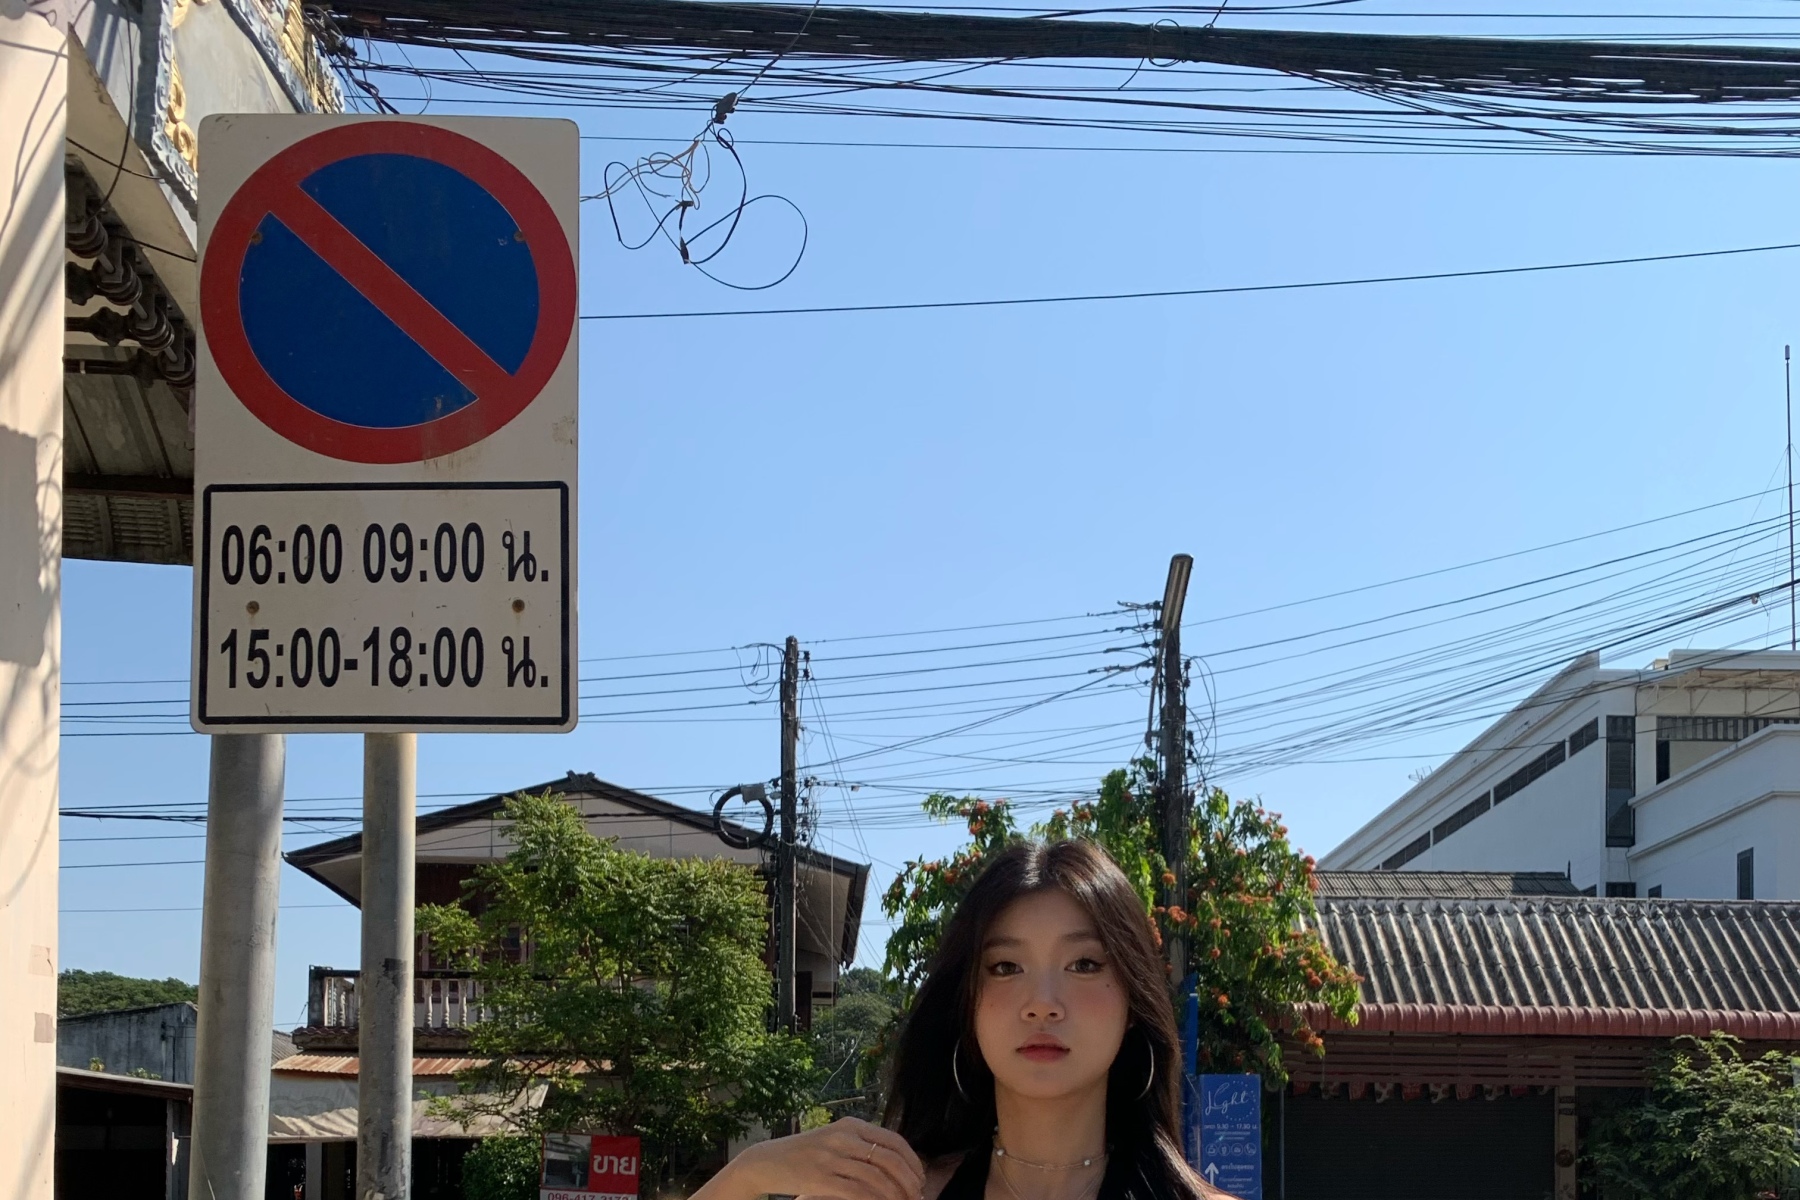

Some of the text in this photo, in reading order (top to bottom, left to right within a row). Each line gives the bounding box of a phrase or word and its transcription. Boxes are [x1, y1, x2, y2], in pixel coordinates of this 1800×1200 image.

[221, 522, 549, 585] 06:00 09:00 น.
[220, 626, 549, 689] 15:00-18:00 น.
[593, 1155, 636, 1175] ขาย
